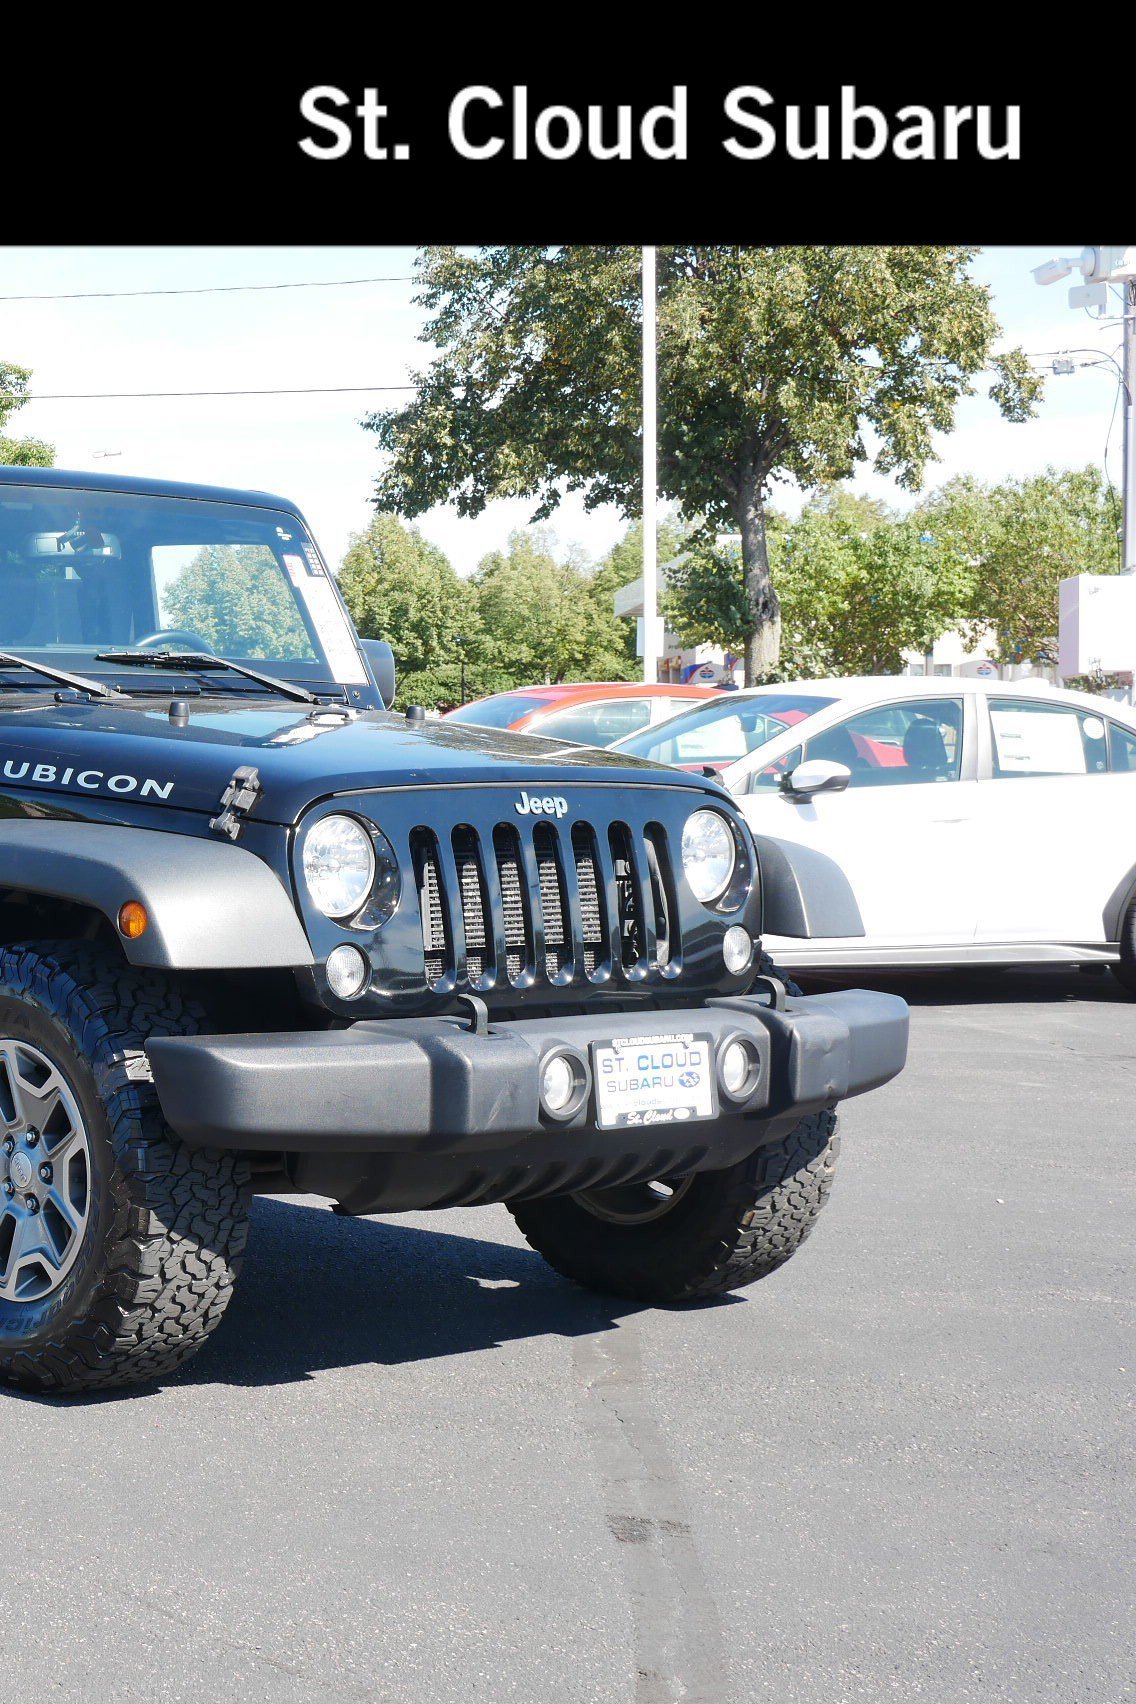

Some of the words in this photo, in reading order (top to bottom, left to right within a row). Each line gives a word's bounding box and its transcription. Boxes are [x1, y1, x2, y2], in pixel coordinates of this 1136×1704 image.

[515, 791, 568, 819] Jeep
[637, 1051, 702, 1072] CLOUD
[607, 1075, 674, 1093] SUBARU
[643, 1109, 674, 1125] Cloud
